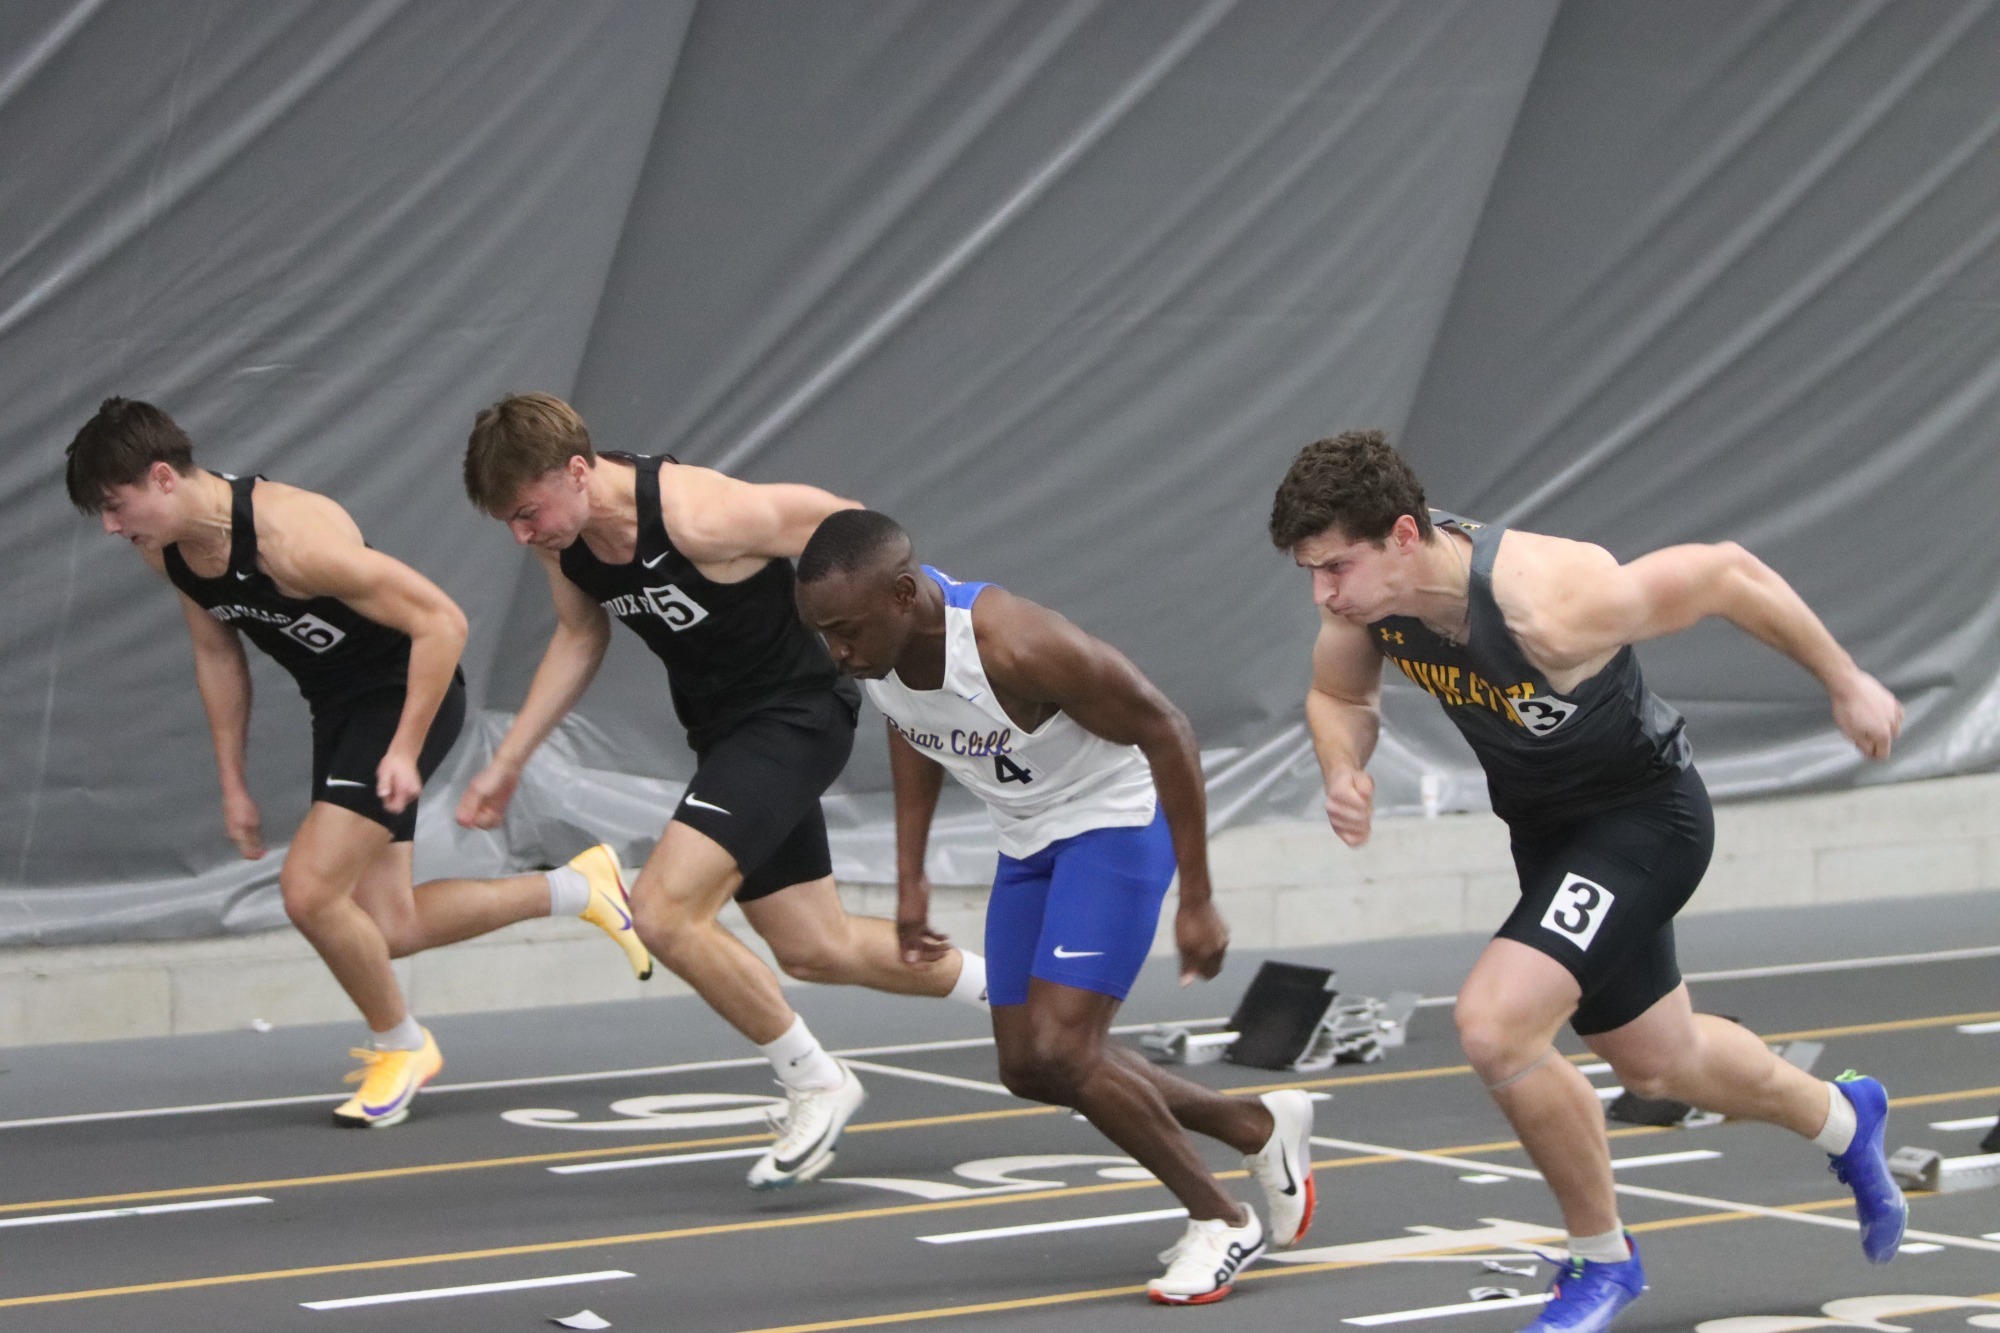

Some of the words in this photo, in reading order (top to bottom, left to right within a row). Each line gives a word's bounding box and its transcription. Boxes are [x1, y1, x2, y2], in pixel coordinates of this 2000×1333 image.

[600, 594, 641, 616] OUX
[649, 589, 695, 626] 5
[290, 622, 334, 648] 6
[1394, 656, 1463, 706] AYNE
[1518, 701, 1567, 731] 3
[951, 728, 1012, 757] Cliff
[994, 754, 1033, 784] 4
[1554, 882, 1601, 934] 3
